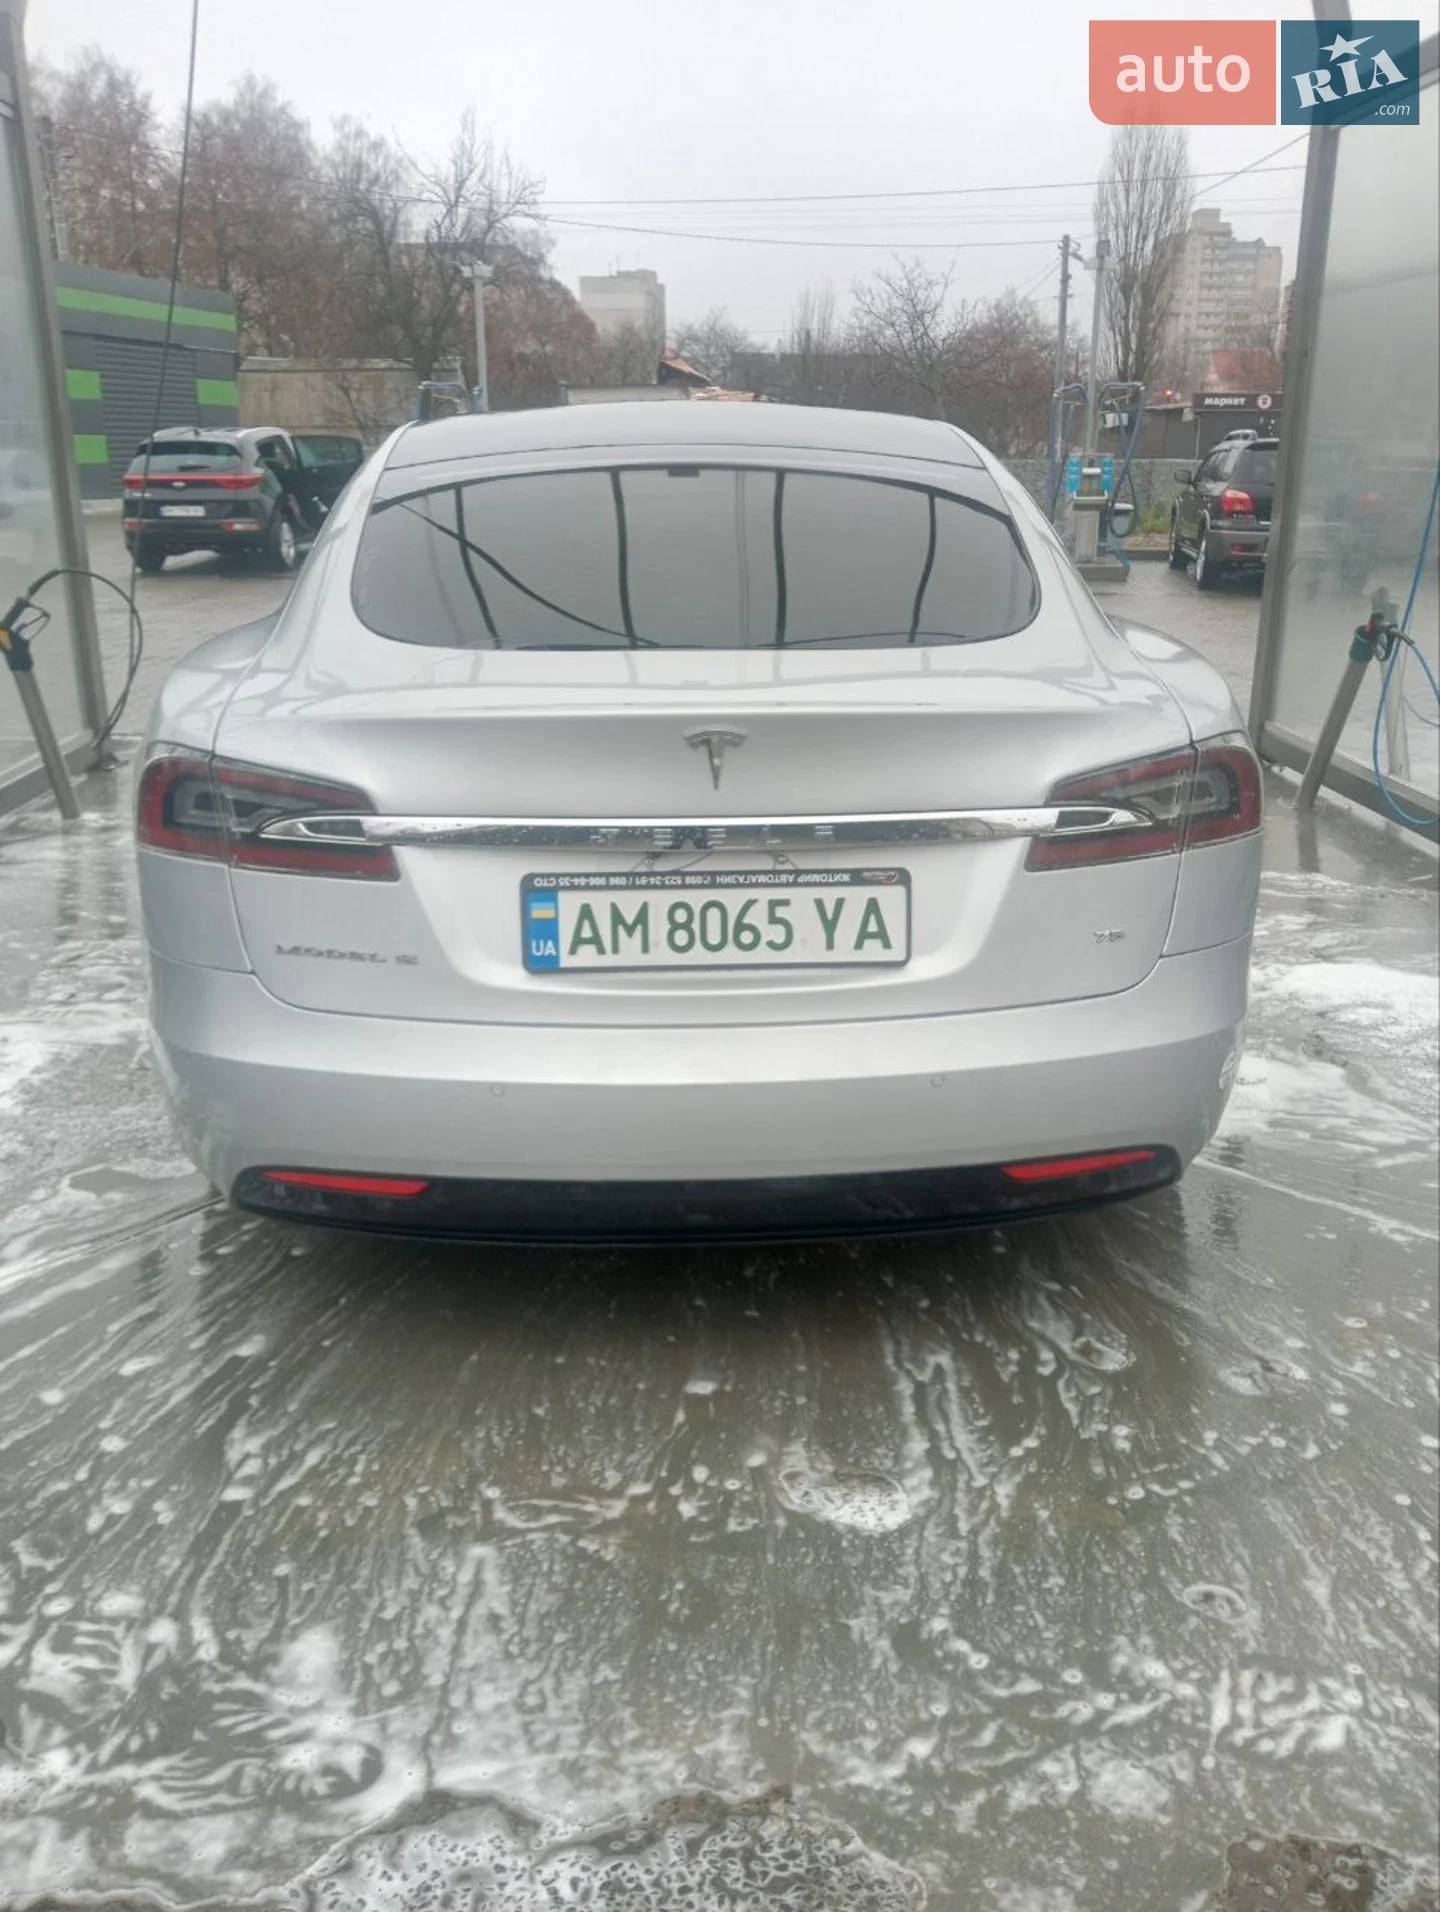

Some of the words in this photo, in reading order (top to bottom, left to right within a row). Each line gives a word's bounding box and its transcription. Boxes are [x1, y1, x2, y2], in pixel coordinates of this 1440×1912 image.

[1204, 397, 1246, 407] маркет
[533, 876, 557, 888] СТО
[715, 873, 796, 885] АВТОМАГАЗИН
[568, 901, 652, 956] AM
[666, 898, 795, 954] 8065
[813, 897, 893, 951] YA
[275, 943, 388, 963] MODEL
[531, 941, 558, 957] UA
